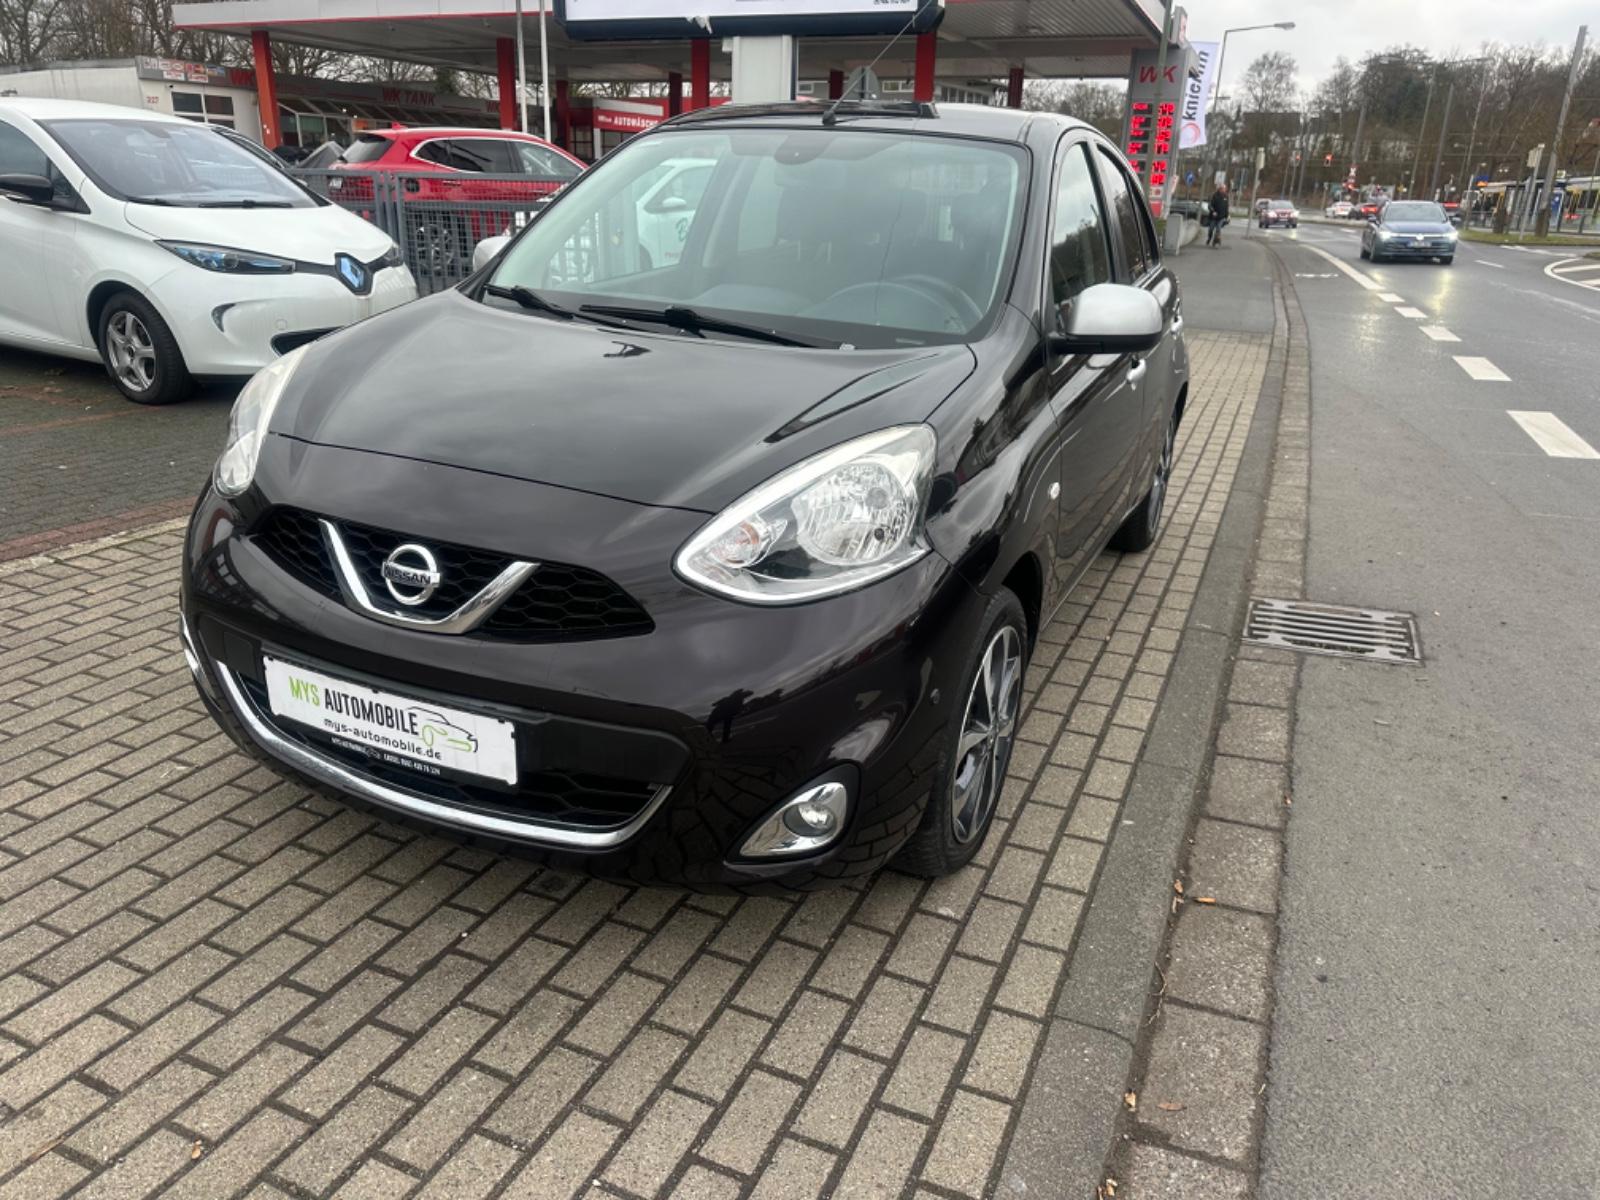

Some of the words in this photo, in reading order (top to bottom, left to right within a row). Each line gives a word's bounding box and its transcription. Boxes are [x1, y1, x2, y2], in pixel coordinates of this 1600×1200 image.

[1139, 64, 1178, 84] WK
[405, 91, 435, 106] TANK
[384, 564, 431, 585] NISSAN
[289, 676, 320, 706] MYS
[324, 688, 419, 736] AUTOMOBILE
[323, 718, 442, 761] mys-automobile.de
